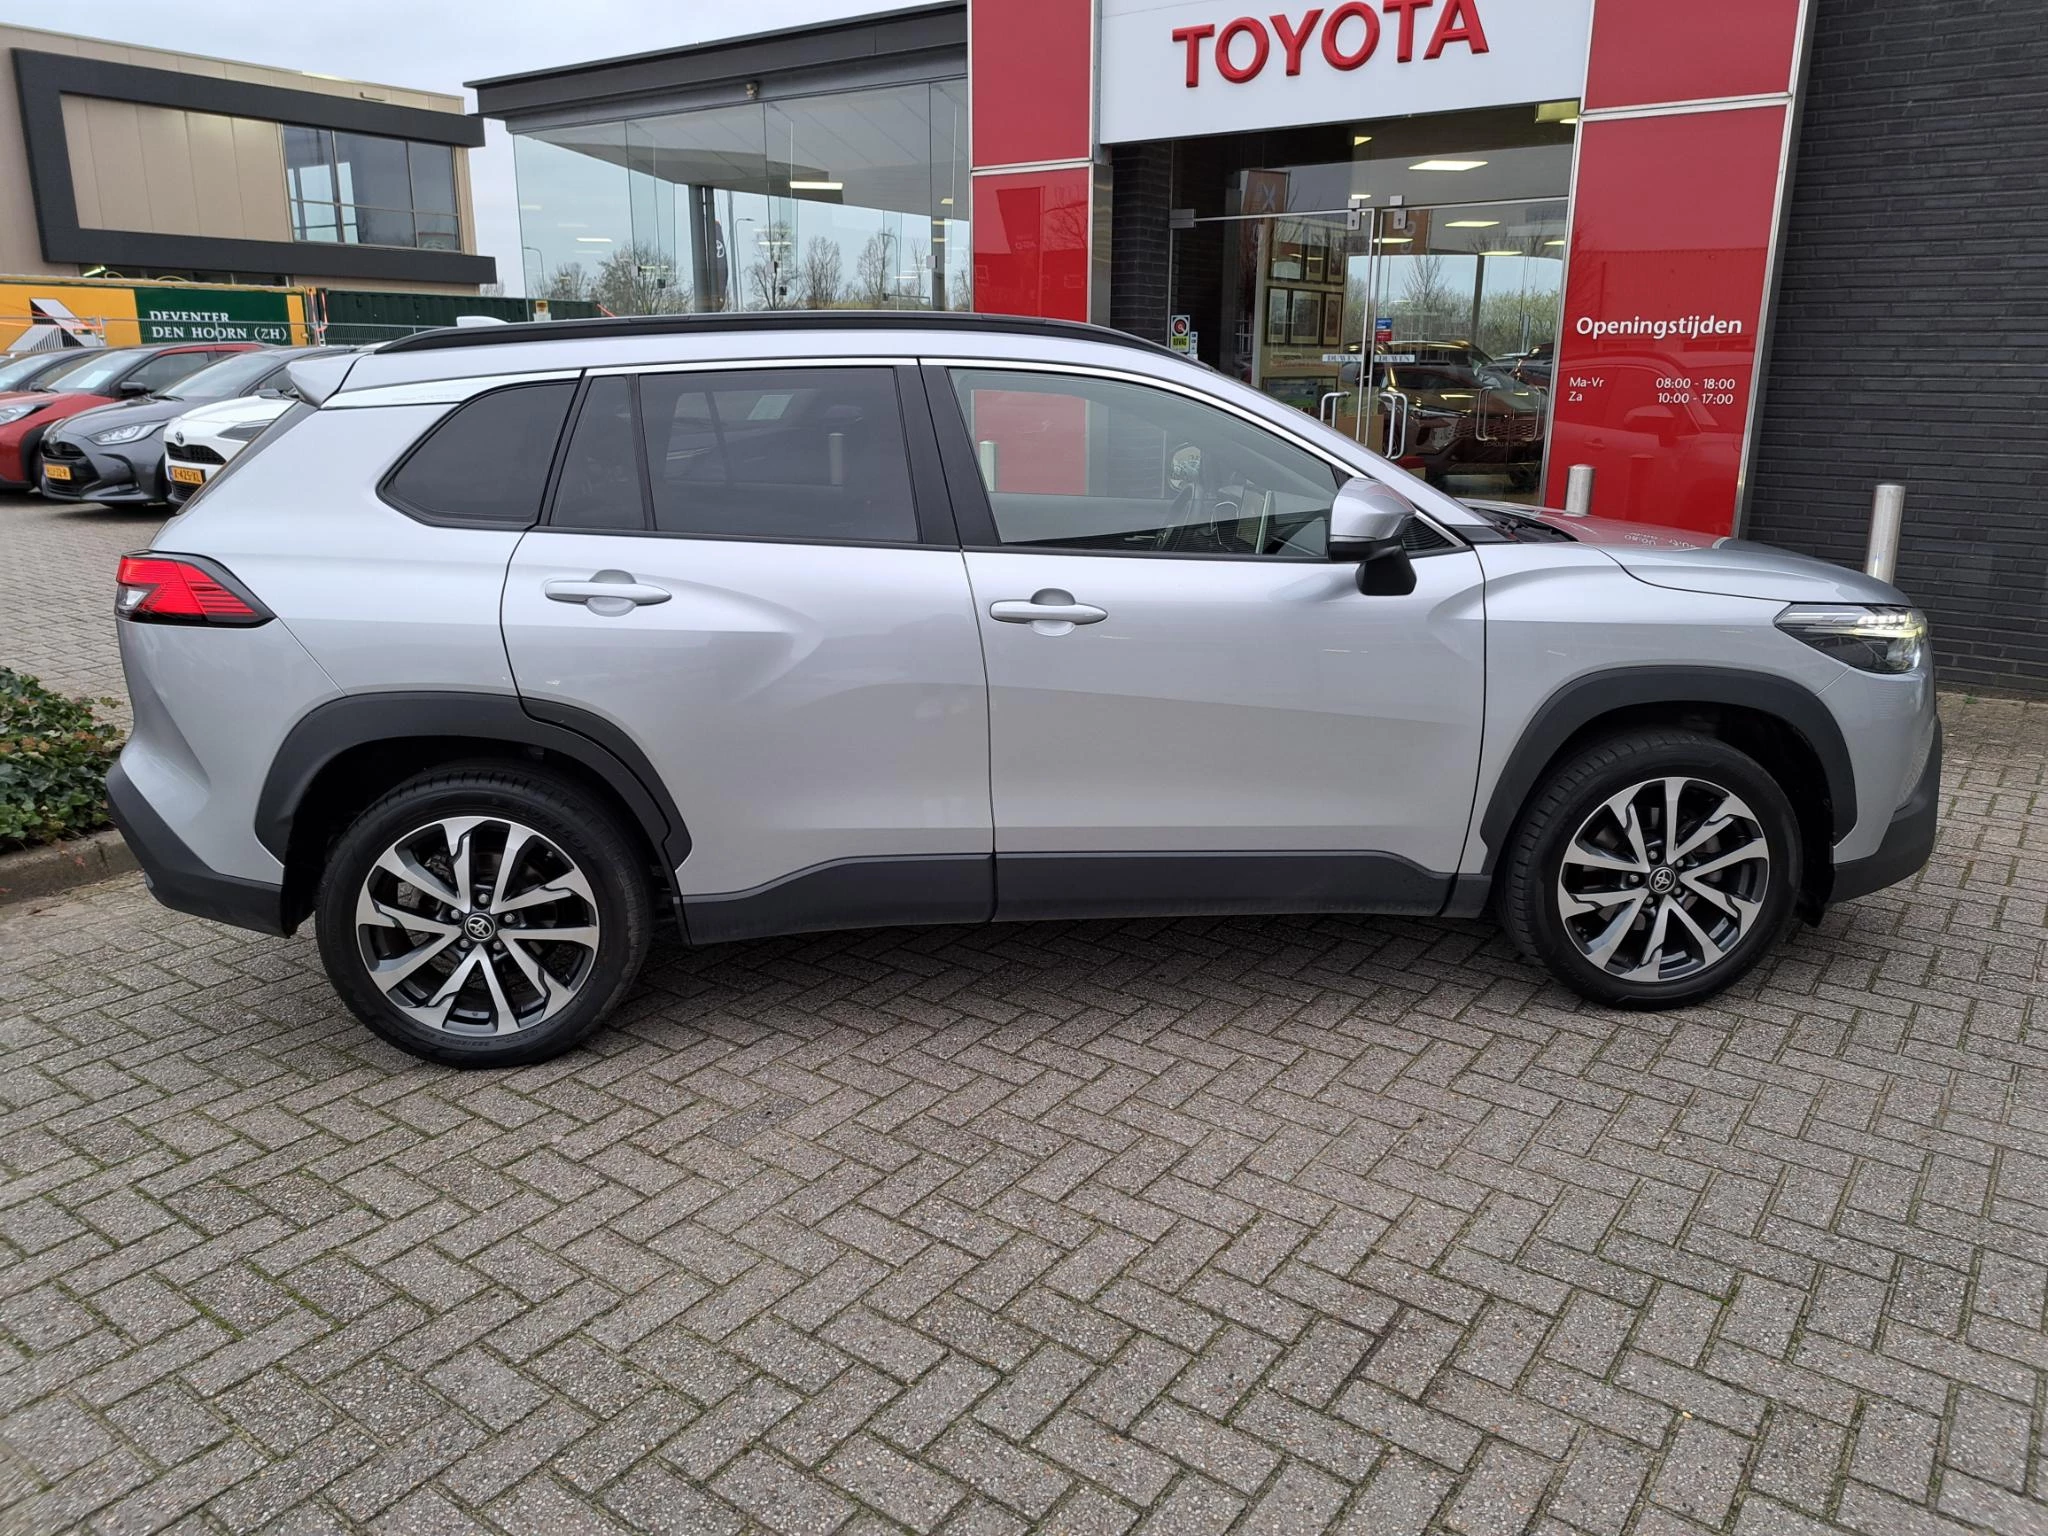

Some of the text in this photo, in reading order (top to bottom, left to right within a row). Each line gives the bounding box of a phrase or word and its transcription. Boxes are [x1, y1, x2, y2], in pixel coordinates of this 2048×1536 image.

[1172, 0, 1490, 88] TOYOTA
[149, 310, 230, 322] DEVENTER
[151, 326, 288, 340] DEN HOORN (ZH)
[1576, 315, 1743, 340] Openingstijden
[1569, 377, 1605, 388] Ma-Vr
[1655, 377, 1691, 389] 08:00
[1703, 378, 1736, 390] 18:00
[1568, 391, 1583, 402] Za
[1657, 392, 1690, 404] 10:00
[1701, 393, 1734, 405] 17:00
